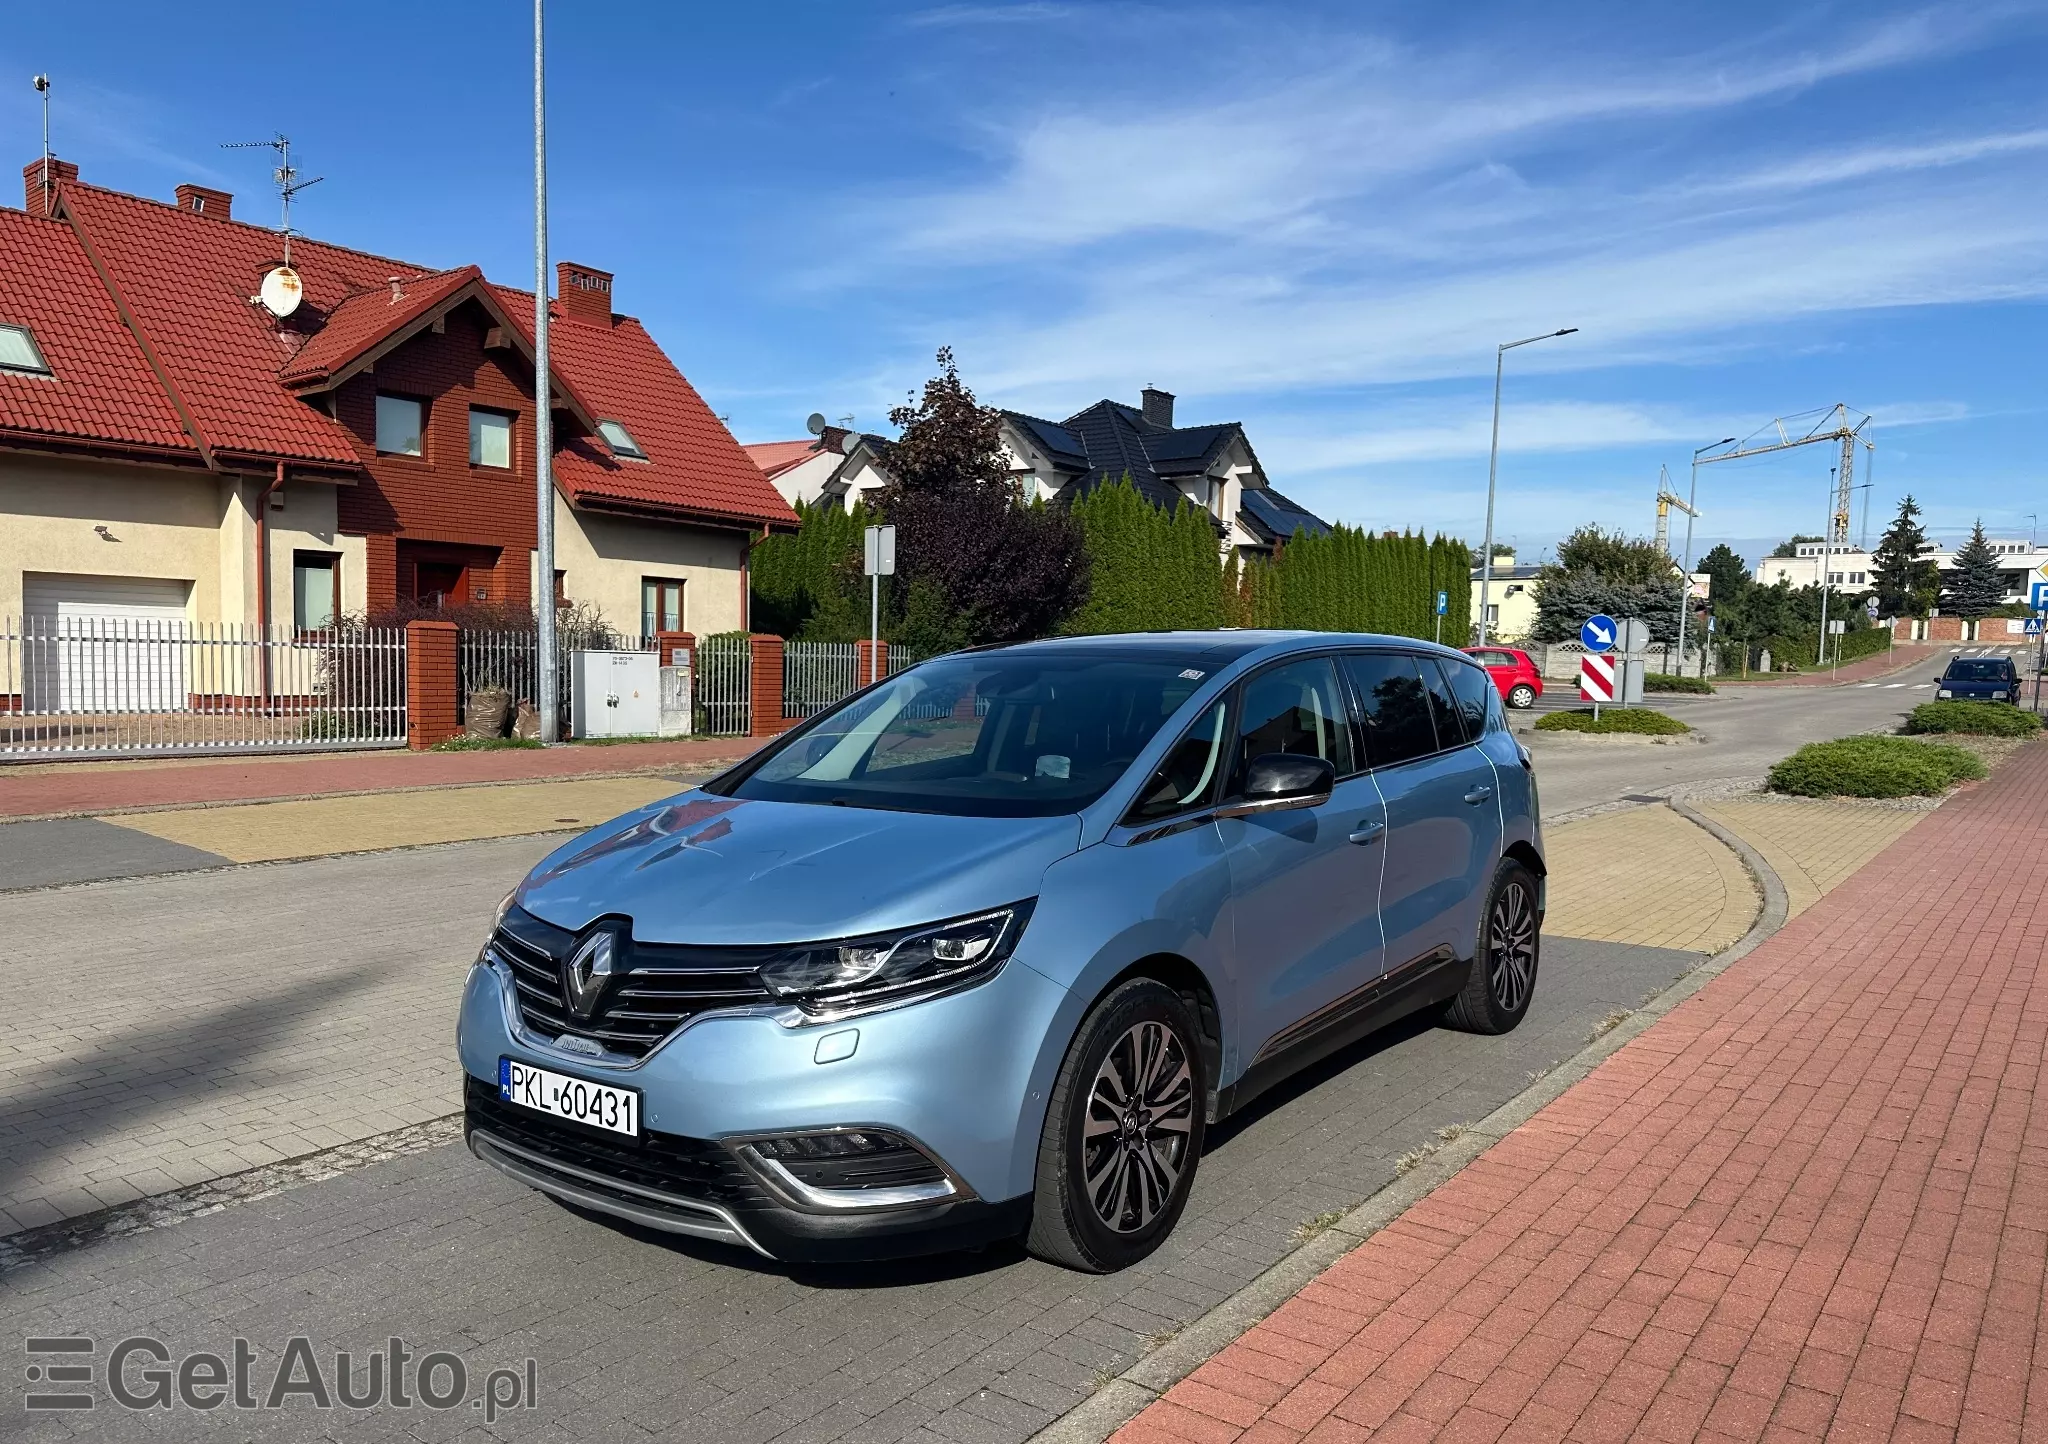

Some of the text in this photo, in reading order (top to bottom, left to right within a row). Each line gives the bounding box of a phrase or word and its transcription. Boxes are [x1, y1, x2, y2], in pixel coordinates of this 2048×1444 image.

[502, 1083, 510, 1095] PL
[511, 1065, 631, 1132] PKL 60431
